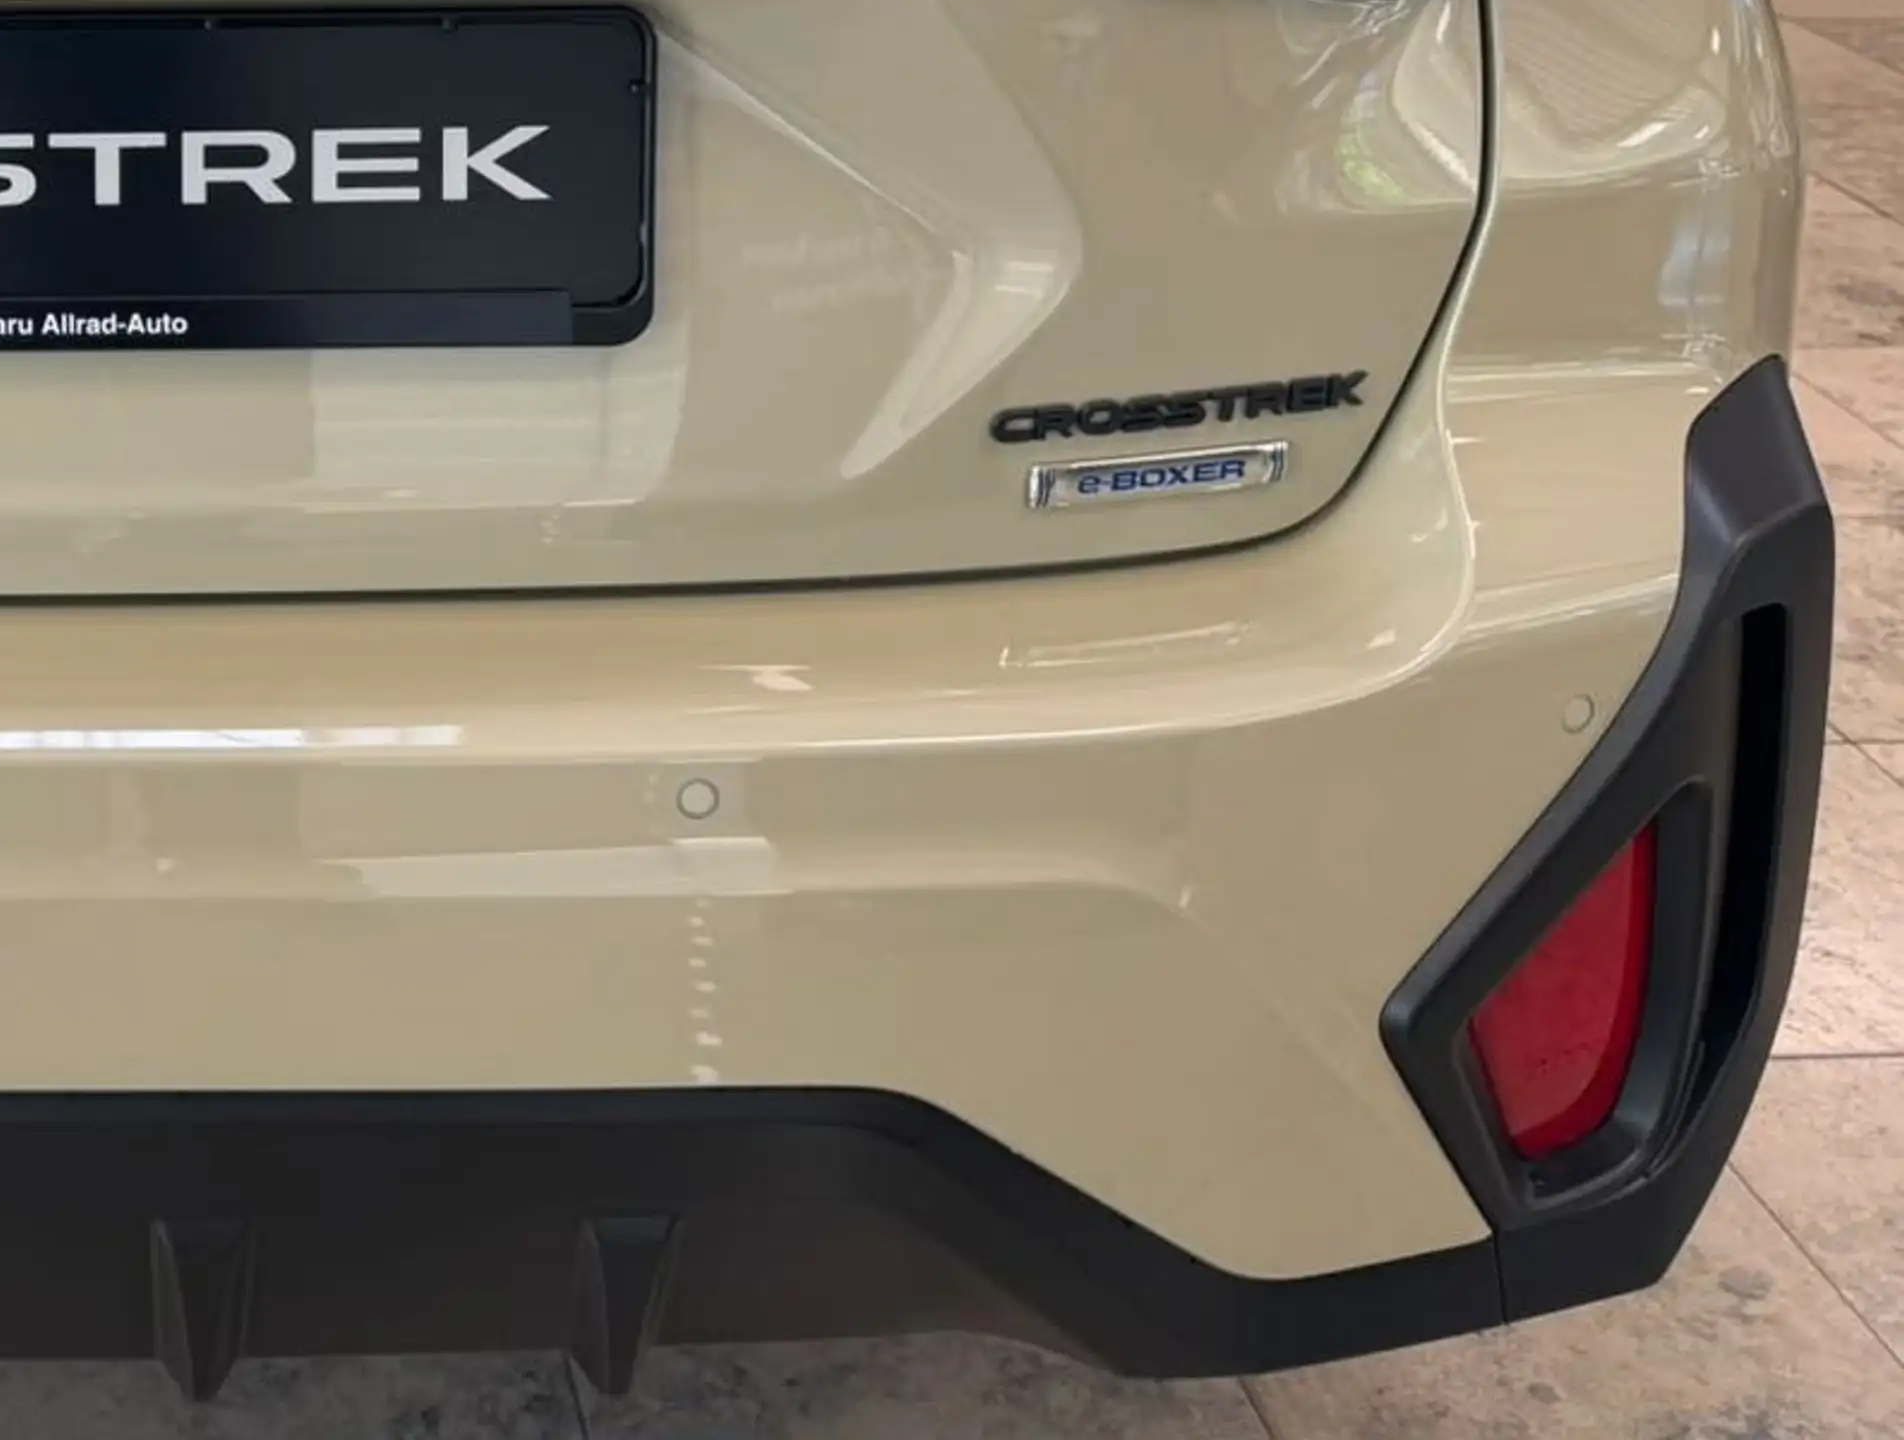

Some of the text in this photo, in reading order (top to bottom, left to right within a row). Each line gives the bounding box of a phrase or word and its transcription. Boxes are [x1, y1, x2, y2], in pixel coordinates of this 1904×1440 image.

[40, 311, 189, 336] Allrad-Auto
[989, 369, 1368, 444] CROSSTREK
[1076, 459, 1246, 495] e-BOXER
